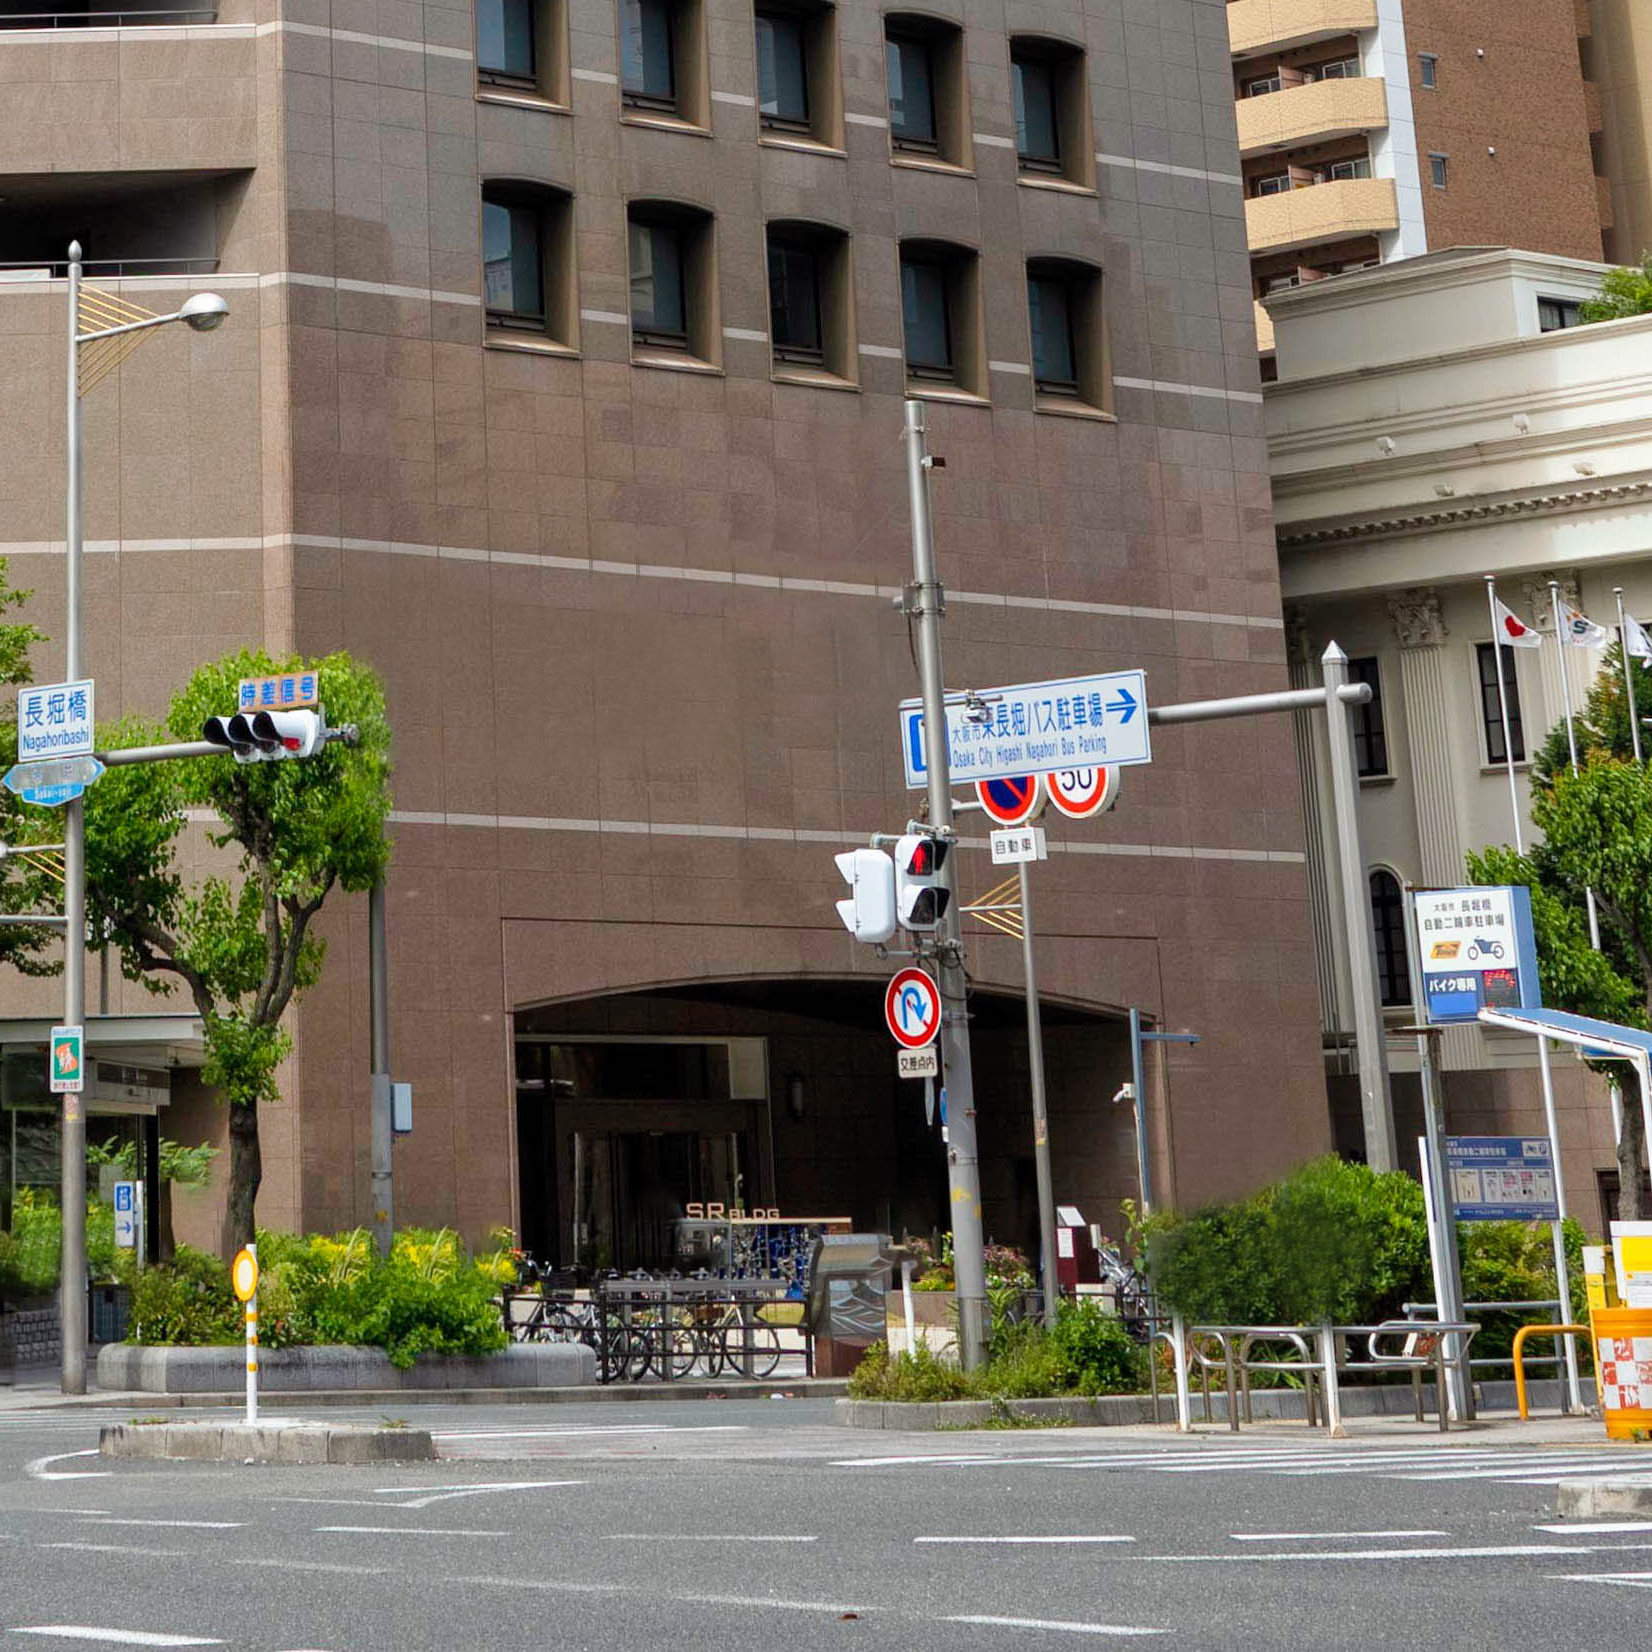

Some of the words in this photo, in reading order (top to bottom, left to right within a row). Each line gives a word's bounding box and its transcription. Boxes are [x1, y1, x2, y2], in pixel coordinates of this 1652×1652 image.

[241, 675, 315, 707] 時差信号
[25, 688, 88, 729] 長堀橋
[23, 727, 90, 753] Nagahoribashi
[952, 749, 976, 769] Osaka
[978, 746, 993, 768] City
[996, 742, 1023, 765] Higashi
[1026, 739, 1059, 763] Nagahori
[1061, 737, 1075, 756] Bus
[1078, 735, 1107, 755] Parking
[1061, 768, 1093, 791] 50
[994, 837, 1033, 856] 自動車
[1428, 977, 1477, 992] バイク専用
[899, 1056, 936, 1072] 交差点内
[686, 1202, 725, 1221] SR
[729, 1208, 780, 1220] BLDG
